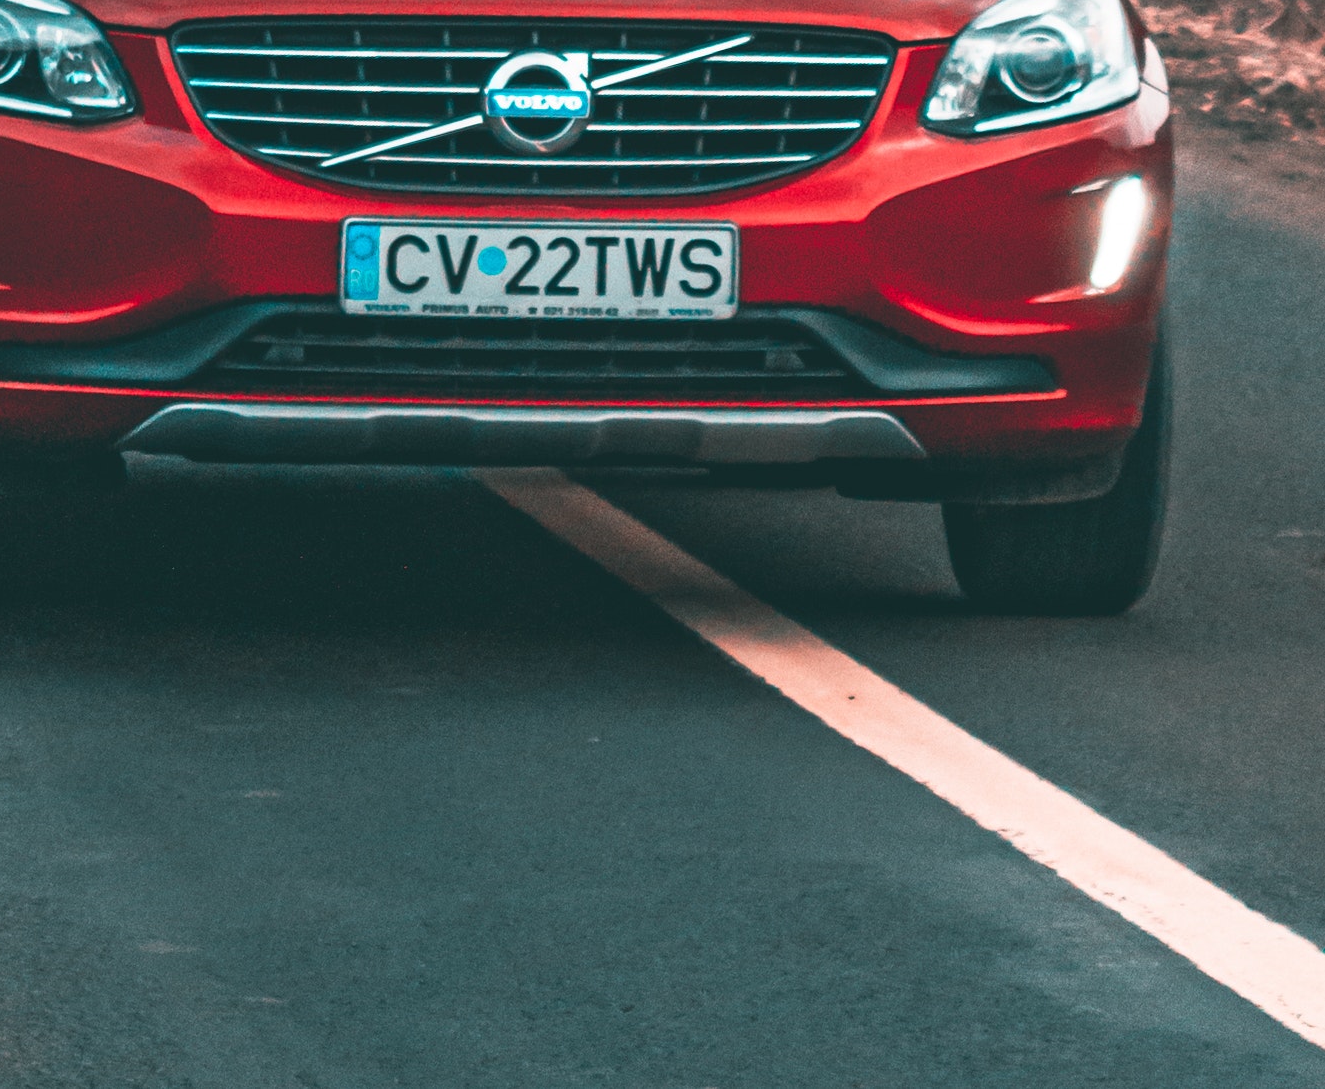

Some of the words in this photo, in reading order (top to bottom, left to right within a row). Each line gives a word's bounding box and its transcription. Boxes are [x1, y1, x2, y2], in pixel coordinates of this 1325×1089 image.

[492, 94, 583, 111] VOLVO
[386, 233, 479, 295] CV
[504, 235, 724, 299] 22TWS
[421, 303, 470, 314] PRIMUS
[475, 304, 510, 315] AUTO
